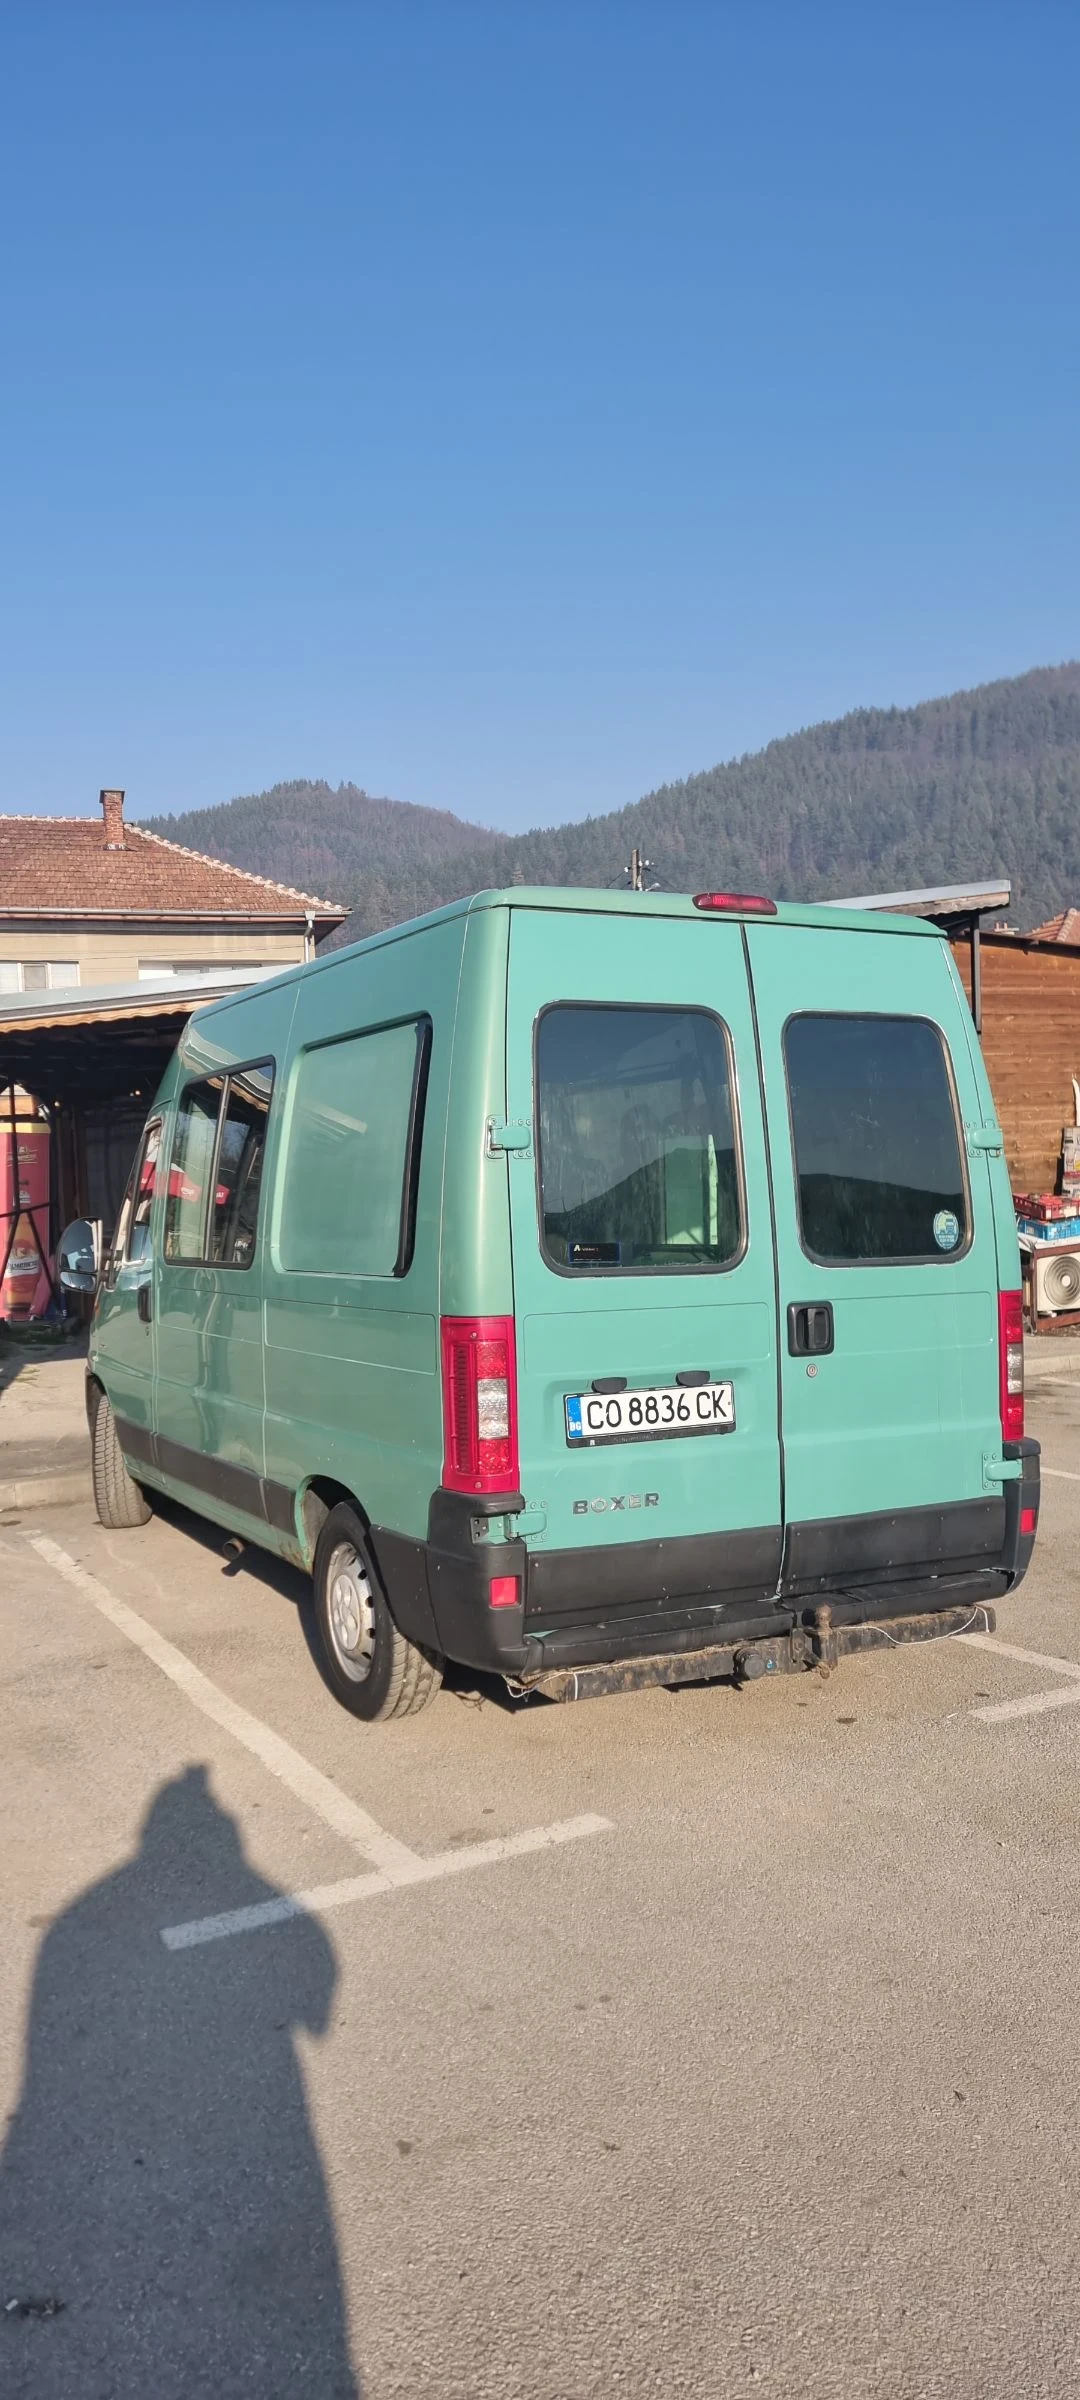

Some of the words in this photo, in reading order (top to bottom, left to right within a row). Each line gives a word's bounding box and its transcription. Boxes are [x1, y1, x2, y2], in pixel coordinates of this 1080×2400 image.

[587, 1399, 622, 1430] CO
[629, 1392, 691, 1426] 8836
[696, 1389, 728, 1420] CK
[569, 1421, 582, 1431] BG
[573, 1492, 660, 1515] BOXER
